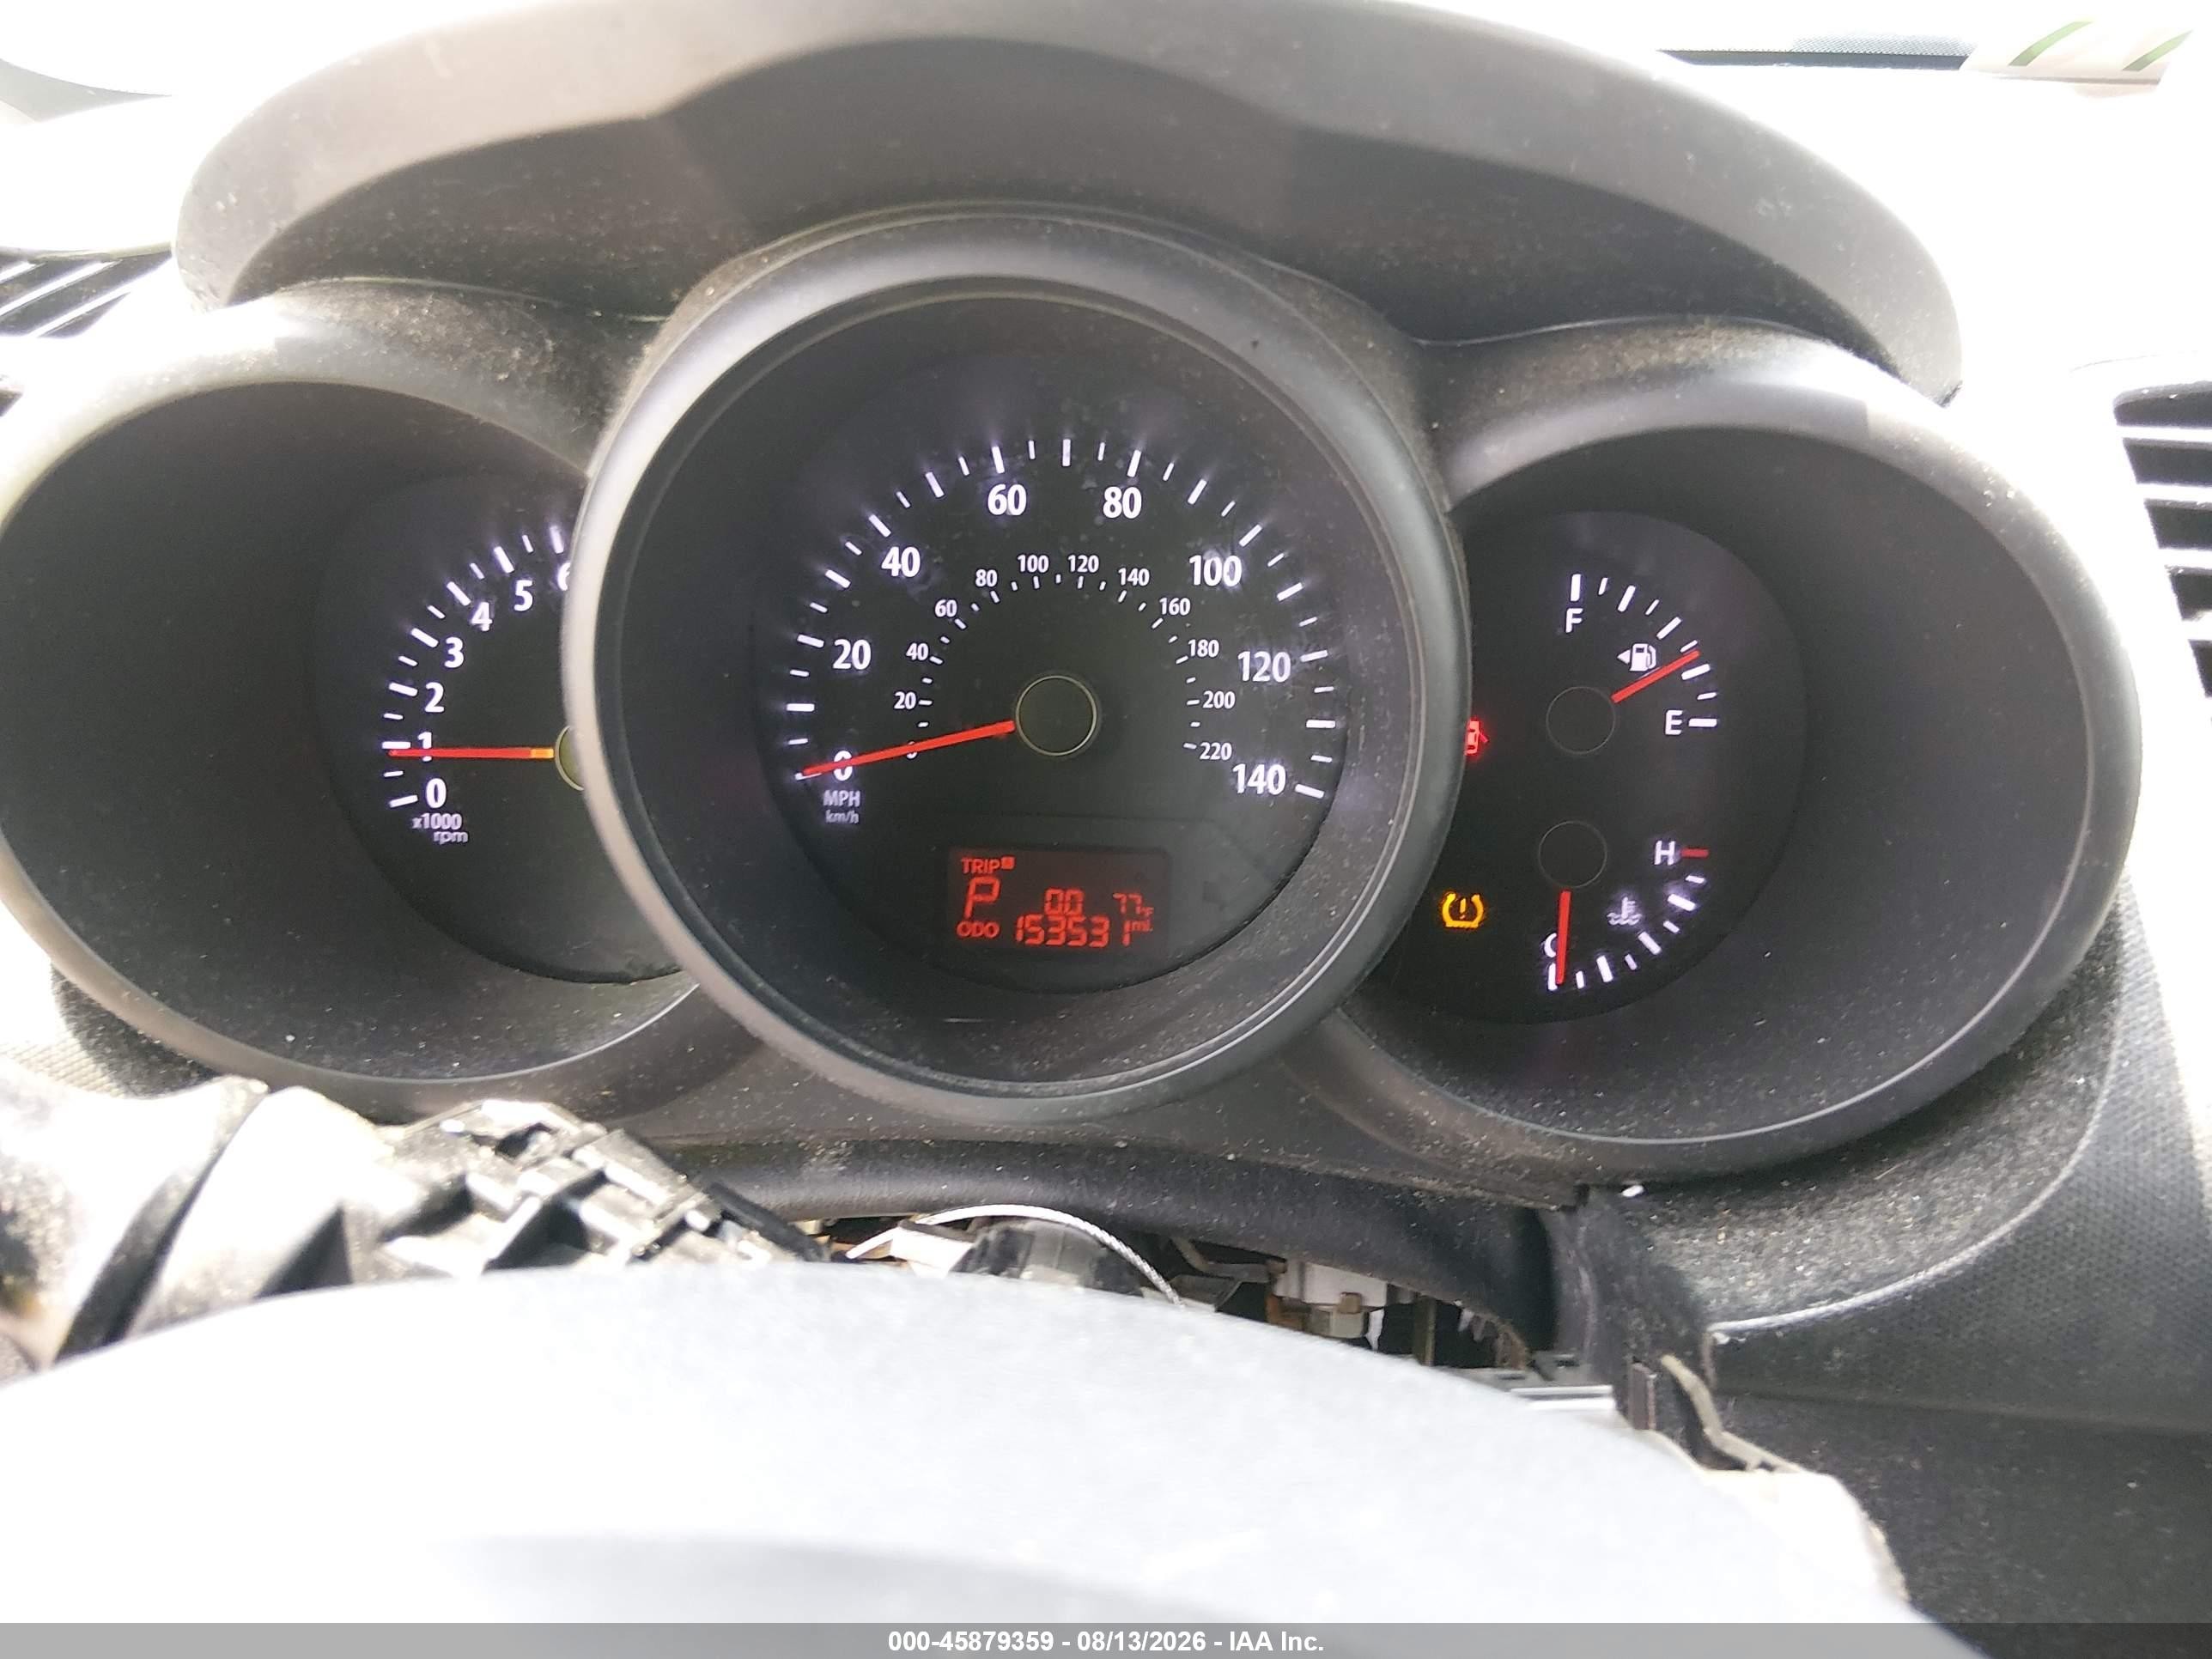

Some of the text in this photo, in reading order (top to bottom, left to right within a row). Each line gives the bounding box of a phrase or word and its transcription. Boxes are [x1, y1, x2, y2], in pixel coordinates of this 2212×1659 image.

[988, 483, 1027, 516] 60
[1103, 486, 1142, 519] 80
[881, 546, 921, 578] 40
[1017, 554, 1049, 574] 100
[1067, 554, 1100, 574] 120
[1188, 554, 1243, 587] 100
[975, 568, 998, 587] 80
[1118, 568, 1150, 586] 140
[514, 579, 534, 611] 5
[934, 599, 957, 617] 60
[1159, 597, 1191, 616] 160
[471, 601, 494, 631] 4
[1565, 607, 1583, 633] F
[443, 636, 465, 668] 3
[832, 639, 872, 670] 20
[906, 642, 929, 660] 40
[1188, 639, 1219, 658] 180
[1237, 650, 1291, 683] 120
[424, 682, 445, 713] 2
[894, 691, 916, 710] 20
[1202, 690, 1236, 709] 200
[1664, 709, 1683, 735] E
[417, 731, 433, 763] 1
[1200, 742, 1233, 761] 220
[833, 750, 854, 781] 0
[1231, 763, 1286, 795] 140
[425, 777, 447, 809] 0
[823, 790, 861, 807] MPH
[412, 812, 462, 830] x1000
[825, 809, 860, 823] km/h
[433, 830, 469, 845] rpm
[961, 858, 1000, 874] TRIP
[1653, 841, 1676, 866] H
[963, 876, 1000, 919] P
[957, 921, 1000, 939] ODO
[1016, 914, 1131, 947] 153531
